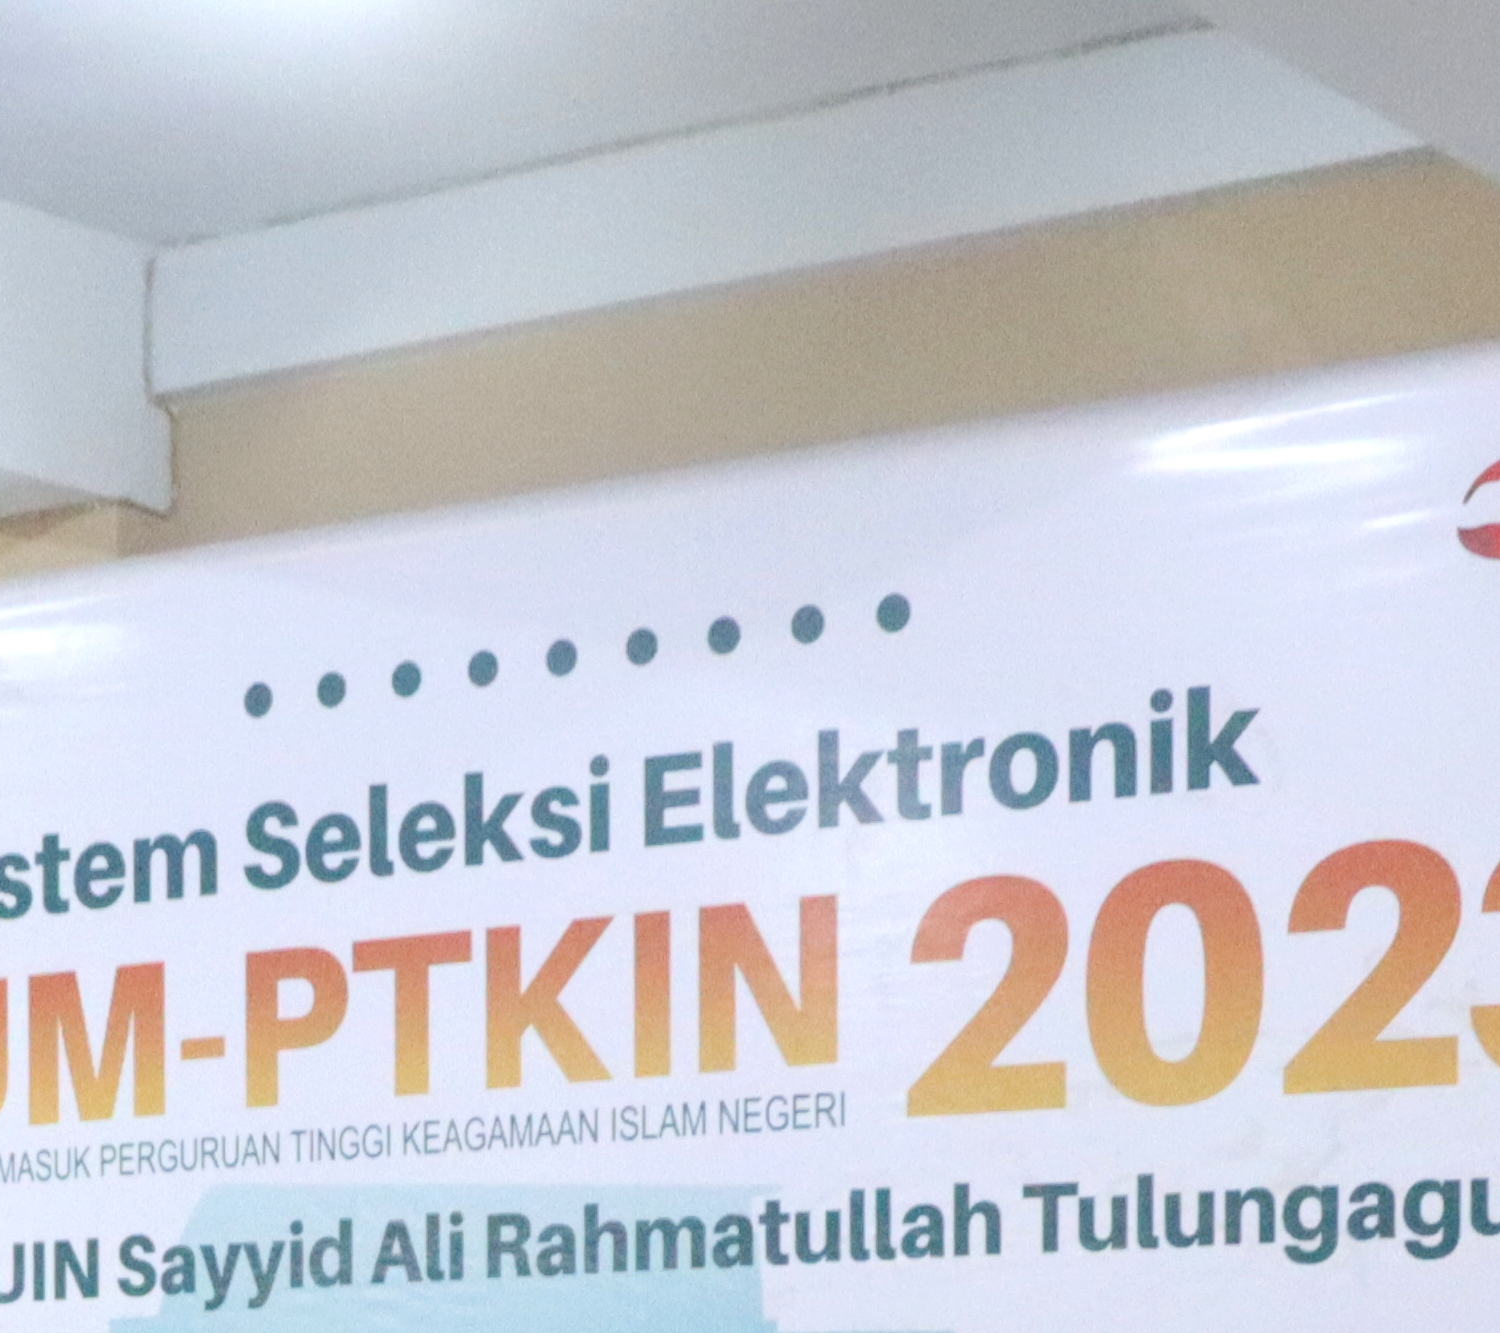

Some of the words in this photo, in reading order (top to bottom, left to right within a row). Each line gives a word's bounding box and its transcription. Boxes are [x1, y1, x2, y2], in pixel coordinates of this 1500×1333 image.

[243, 754, 610, 889] Seleksi
[643, 685, 1261, 848] Elektronik
[100, 1132, 281, 1177] PERGURUAN
[290, 1124, 392, 1162] TINGGI
[403, 1109, 599, 1155] KEAGAMAAN
[611, 1100, 707, 1142] ISLAM
[719, 1091, 847, 1134] NEGERI
[117, 1218, 353, 1311] Sayyid
[370, 1211, 465, 1283] Ali
[486, 1183, 999, 1279] Rahmatullah
